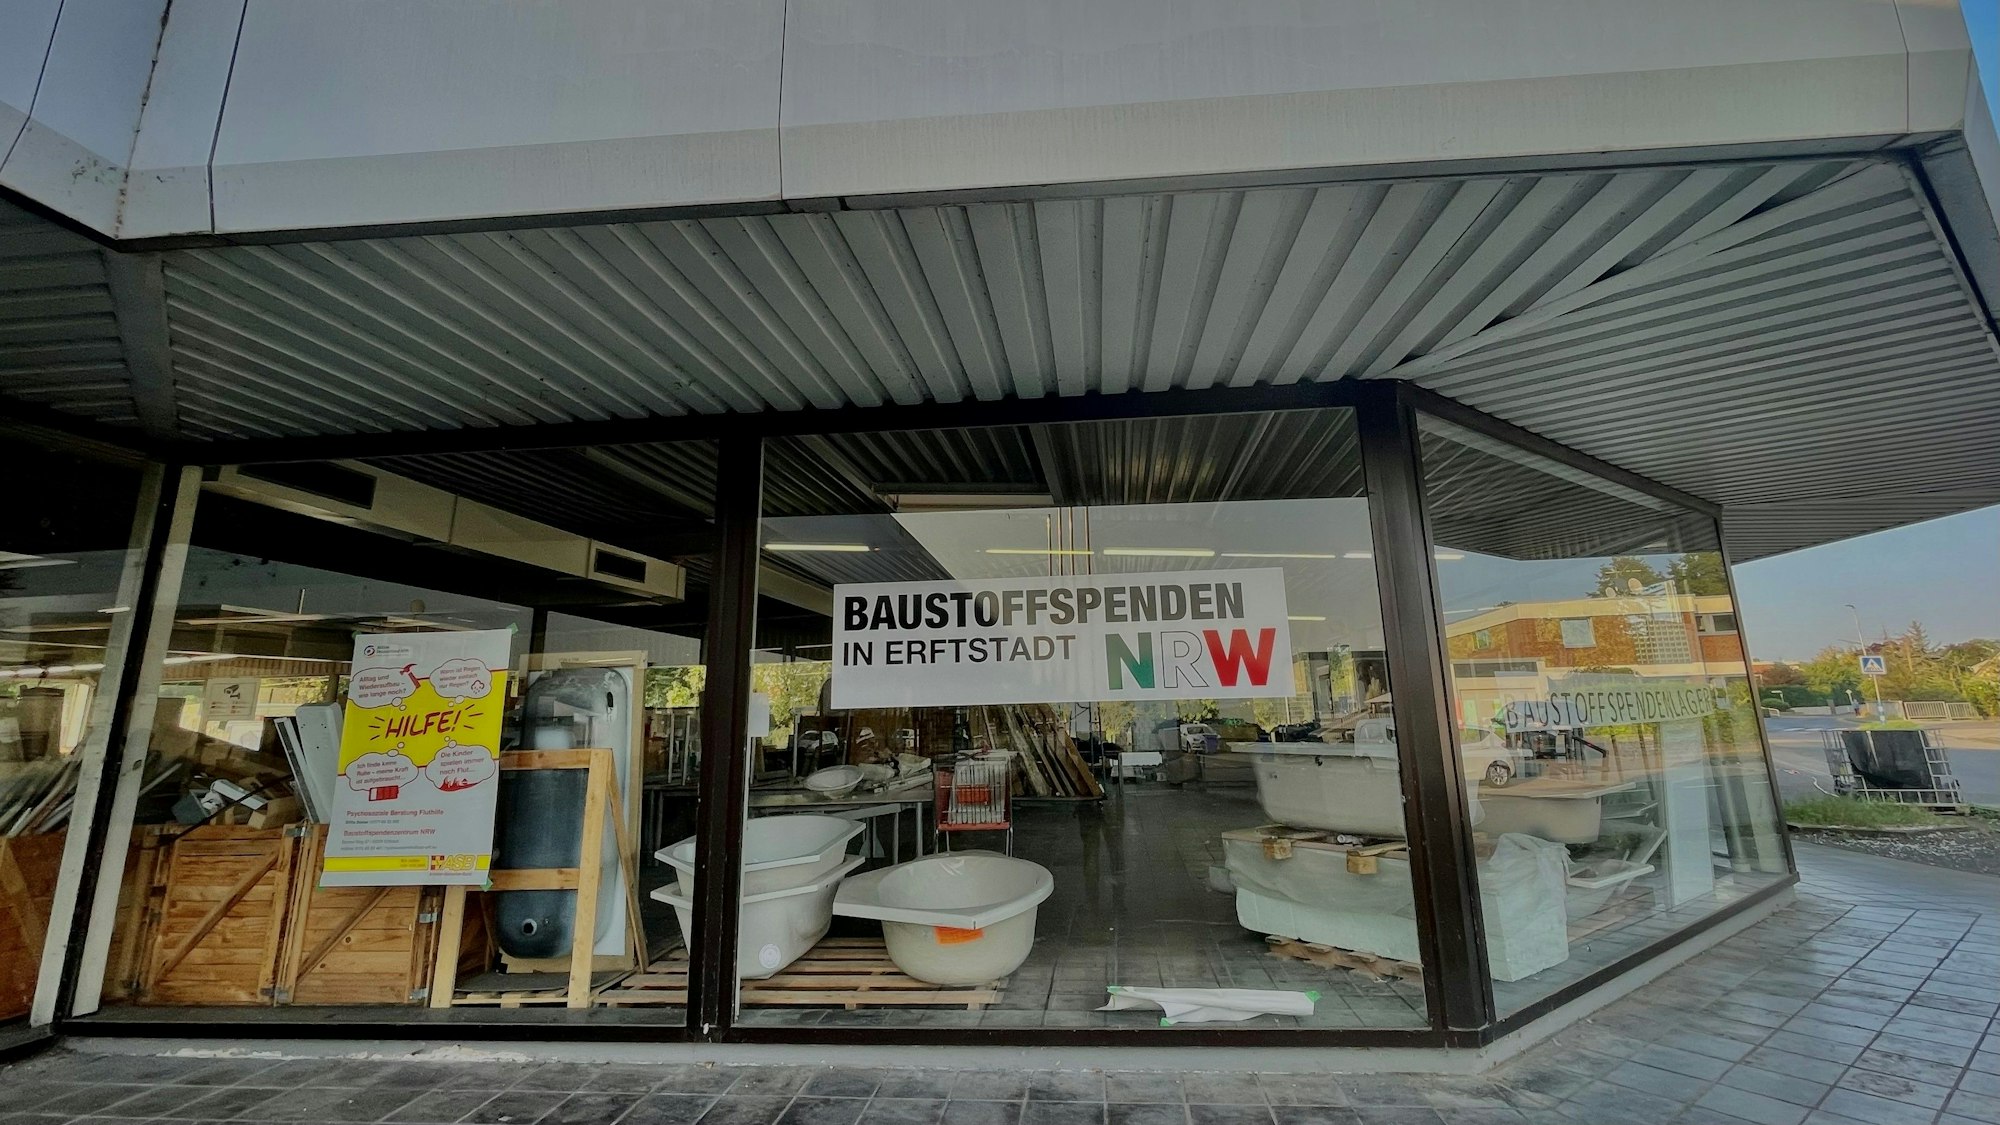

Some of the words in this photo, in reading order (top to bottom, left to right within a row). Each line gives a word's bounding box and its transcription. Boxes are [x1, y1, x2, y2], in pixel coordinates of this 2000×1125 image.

[844, 582, 1245, 631] BAUSTOFFSPENDEN
[843, 641, 873, 667] IN
[885, 635, 1076, 665] ERFTSTADT
[1105, 628, 1277, 690] NRW
[1504, 687, 1712, 728] BAUSTOFFSPENDENLAGER
[385, 710, 461, 738] HILFE!
[390, 809, 418, 817] Beratung
[444, 854, 476, 871] ASB
